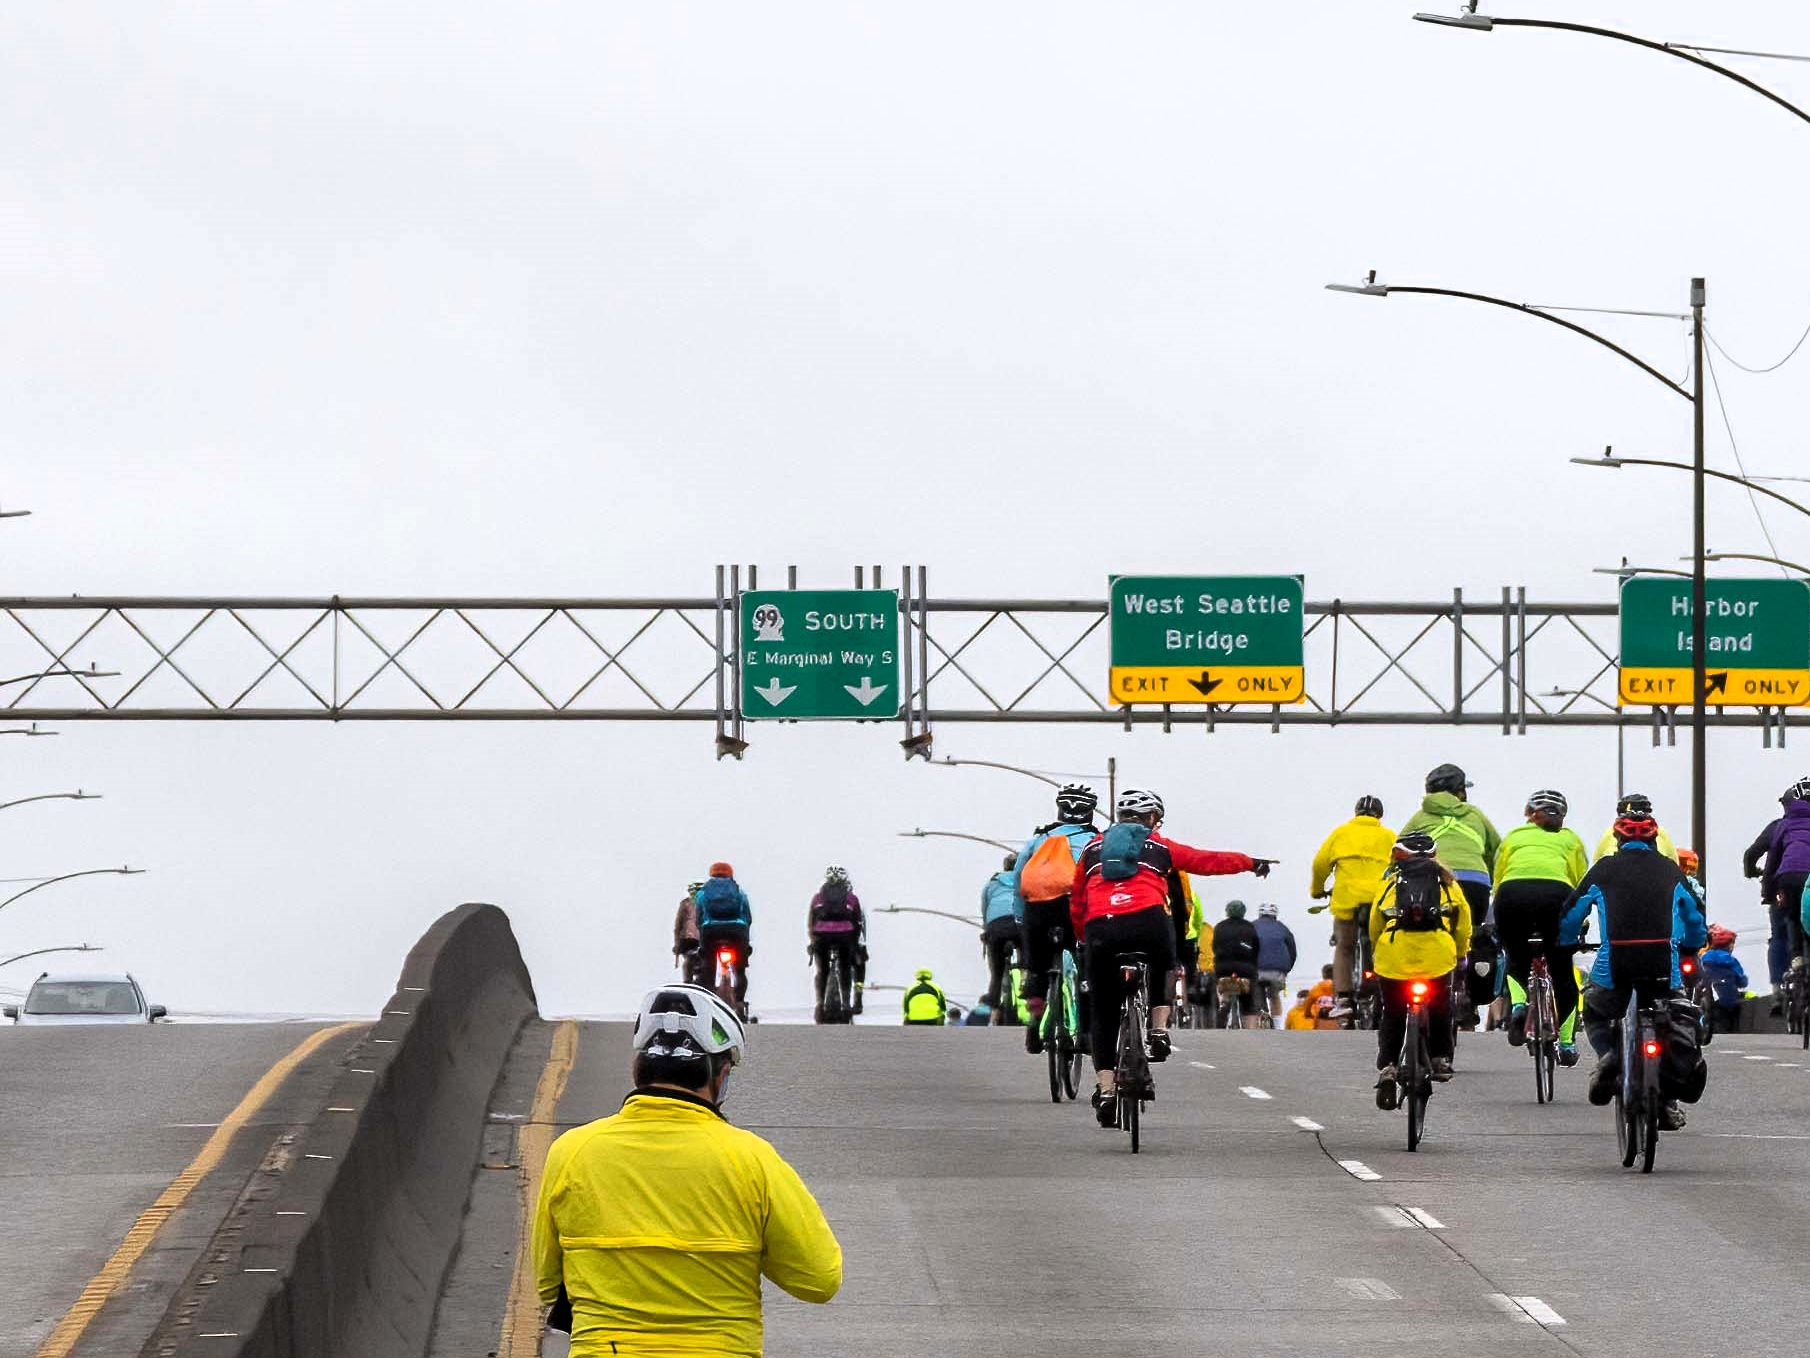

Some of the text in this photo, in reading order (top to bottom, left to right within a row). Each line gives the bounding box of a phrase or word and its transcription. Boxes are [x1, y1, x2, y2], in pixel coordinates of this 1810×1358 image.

[1124, 594, 1291, 614] West Seattle
[1671, 595, 1759, 617] Hrbor
[754, 608, 885, 631] 99 SOUTH
[1166, 629, 1249, 656] Bridge
[1677, 631, 1753, 652] Isand
[746, 650, 894, 668] E Marginal Way S
[1122, 676, 1293, 692] EXIT ONLY
[1629, 677, 1800, 695] EXIT ONLY
